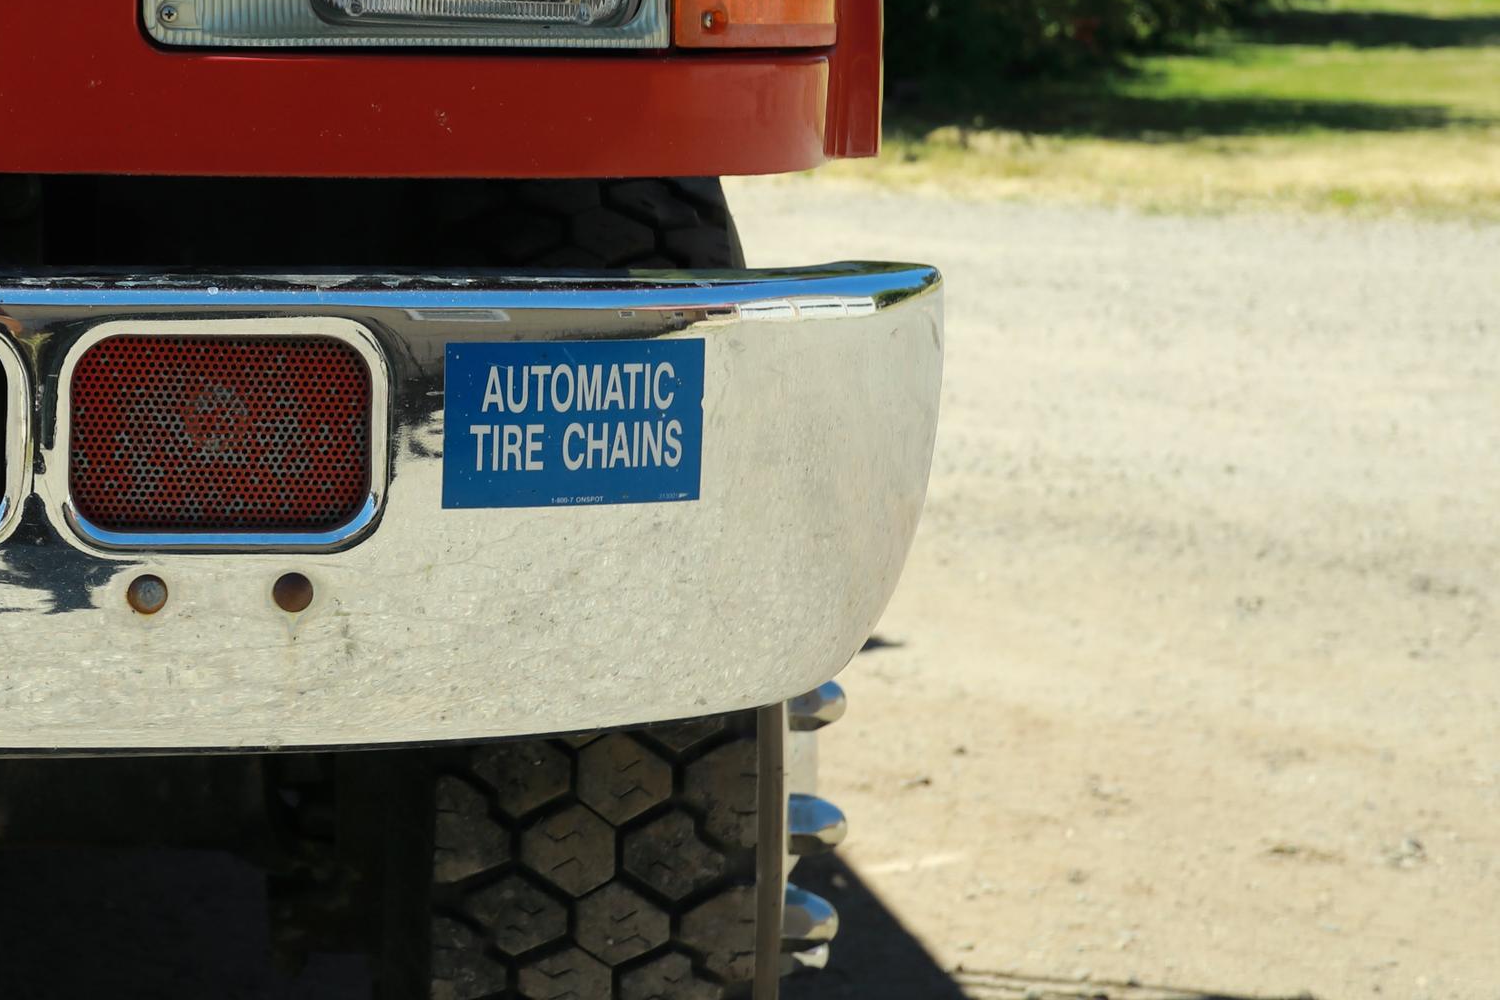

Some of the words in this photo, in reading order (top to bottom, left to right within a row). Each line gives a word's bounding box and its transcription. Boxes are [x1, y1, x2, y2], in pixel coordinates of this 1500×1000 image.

[480, 361, 676, 414] AUTOMATIC
[469, 423, 545, 472] TIRE
[561, 419, 683, 471] CHAINS
[575, 495, 604, 504] ONSPOT
